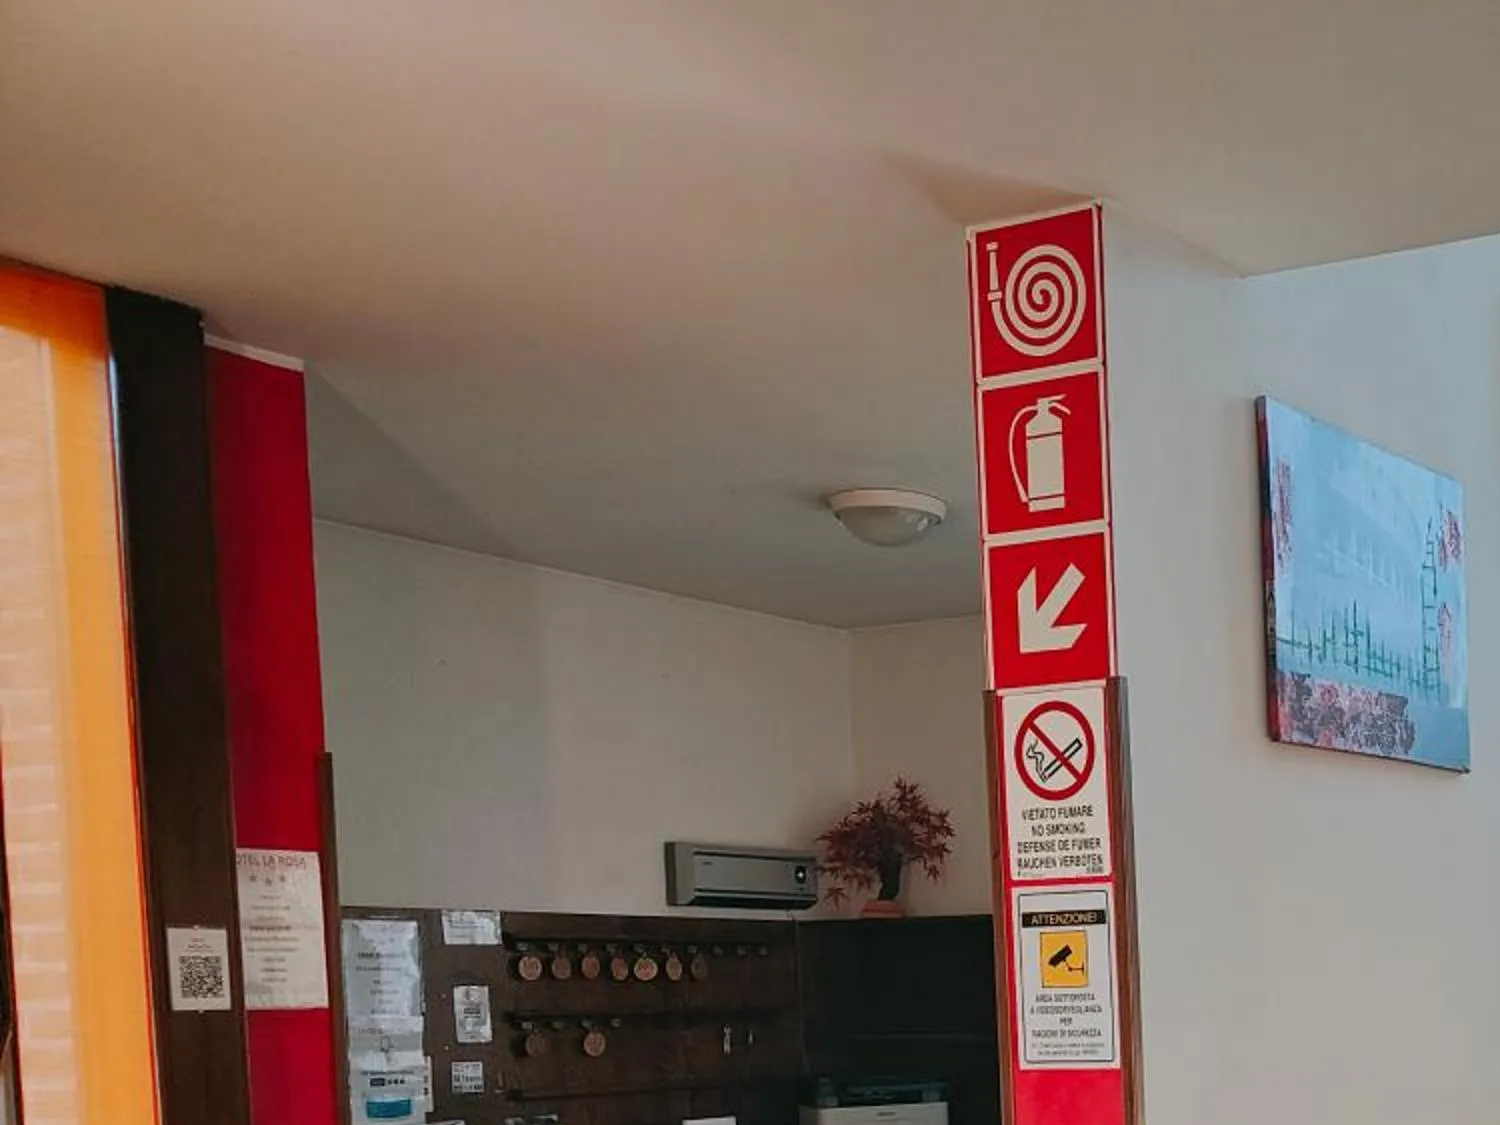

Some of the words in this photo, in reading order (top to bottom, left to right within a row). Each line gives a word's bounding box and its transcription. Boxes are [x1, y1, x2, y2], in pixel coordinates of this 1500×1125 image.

[1022, 807, 1056, 820] VIETATO
[1058, 805, 1094, 818] FUMARE
[1031, 824, 1043, 836] NO
[1046, 822, 1085, 836] SMOKING
[1017, 840, 1057, 854] DEFENSE
[1058, 839, 1070, 851] DE
[1072, 838, 1102, 850] FUMER
[1031, 912, 1097, 926] ATTENZIONE!
